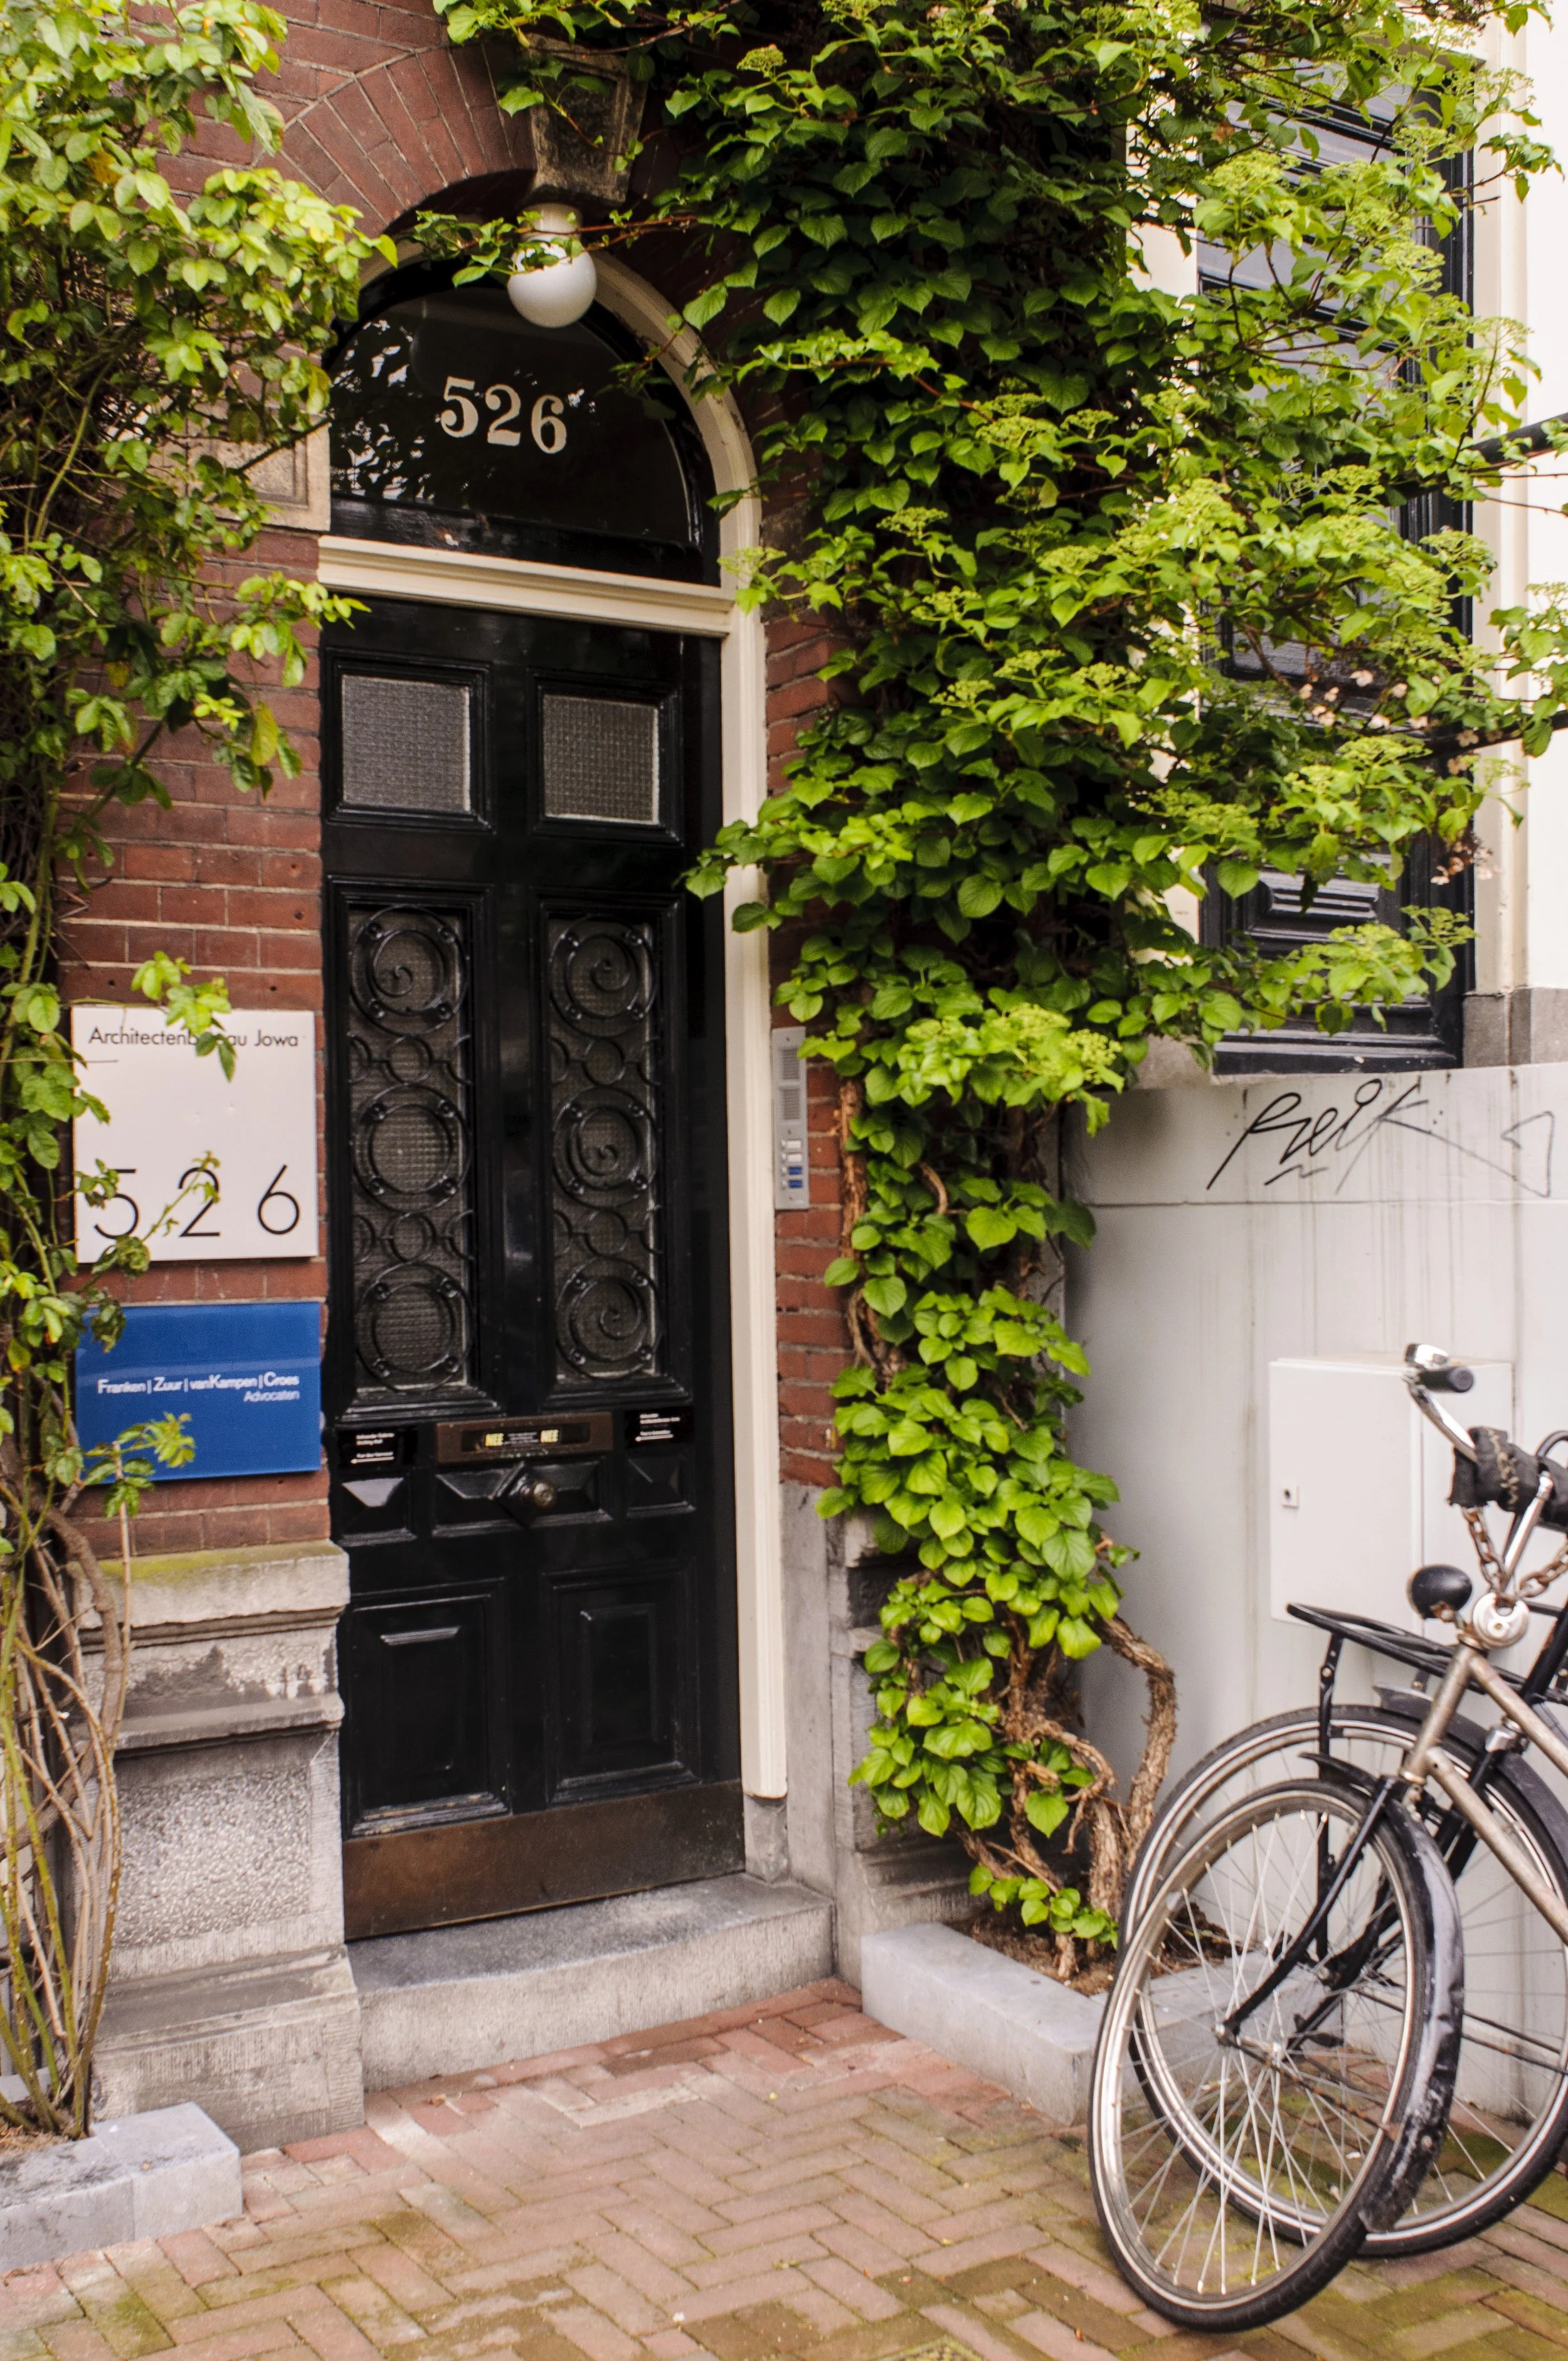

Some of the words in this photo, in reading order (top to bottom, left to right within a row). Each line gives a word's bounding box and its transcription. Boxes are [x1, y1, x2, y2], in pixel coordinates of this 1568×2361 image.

[440, 376, 567, 454] 526
[88, 1026, 247, 1047] Architectenbau
[254, 1029, 299, 1047] Jowa
[93, 1164, 300, 1239] 526
